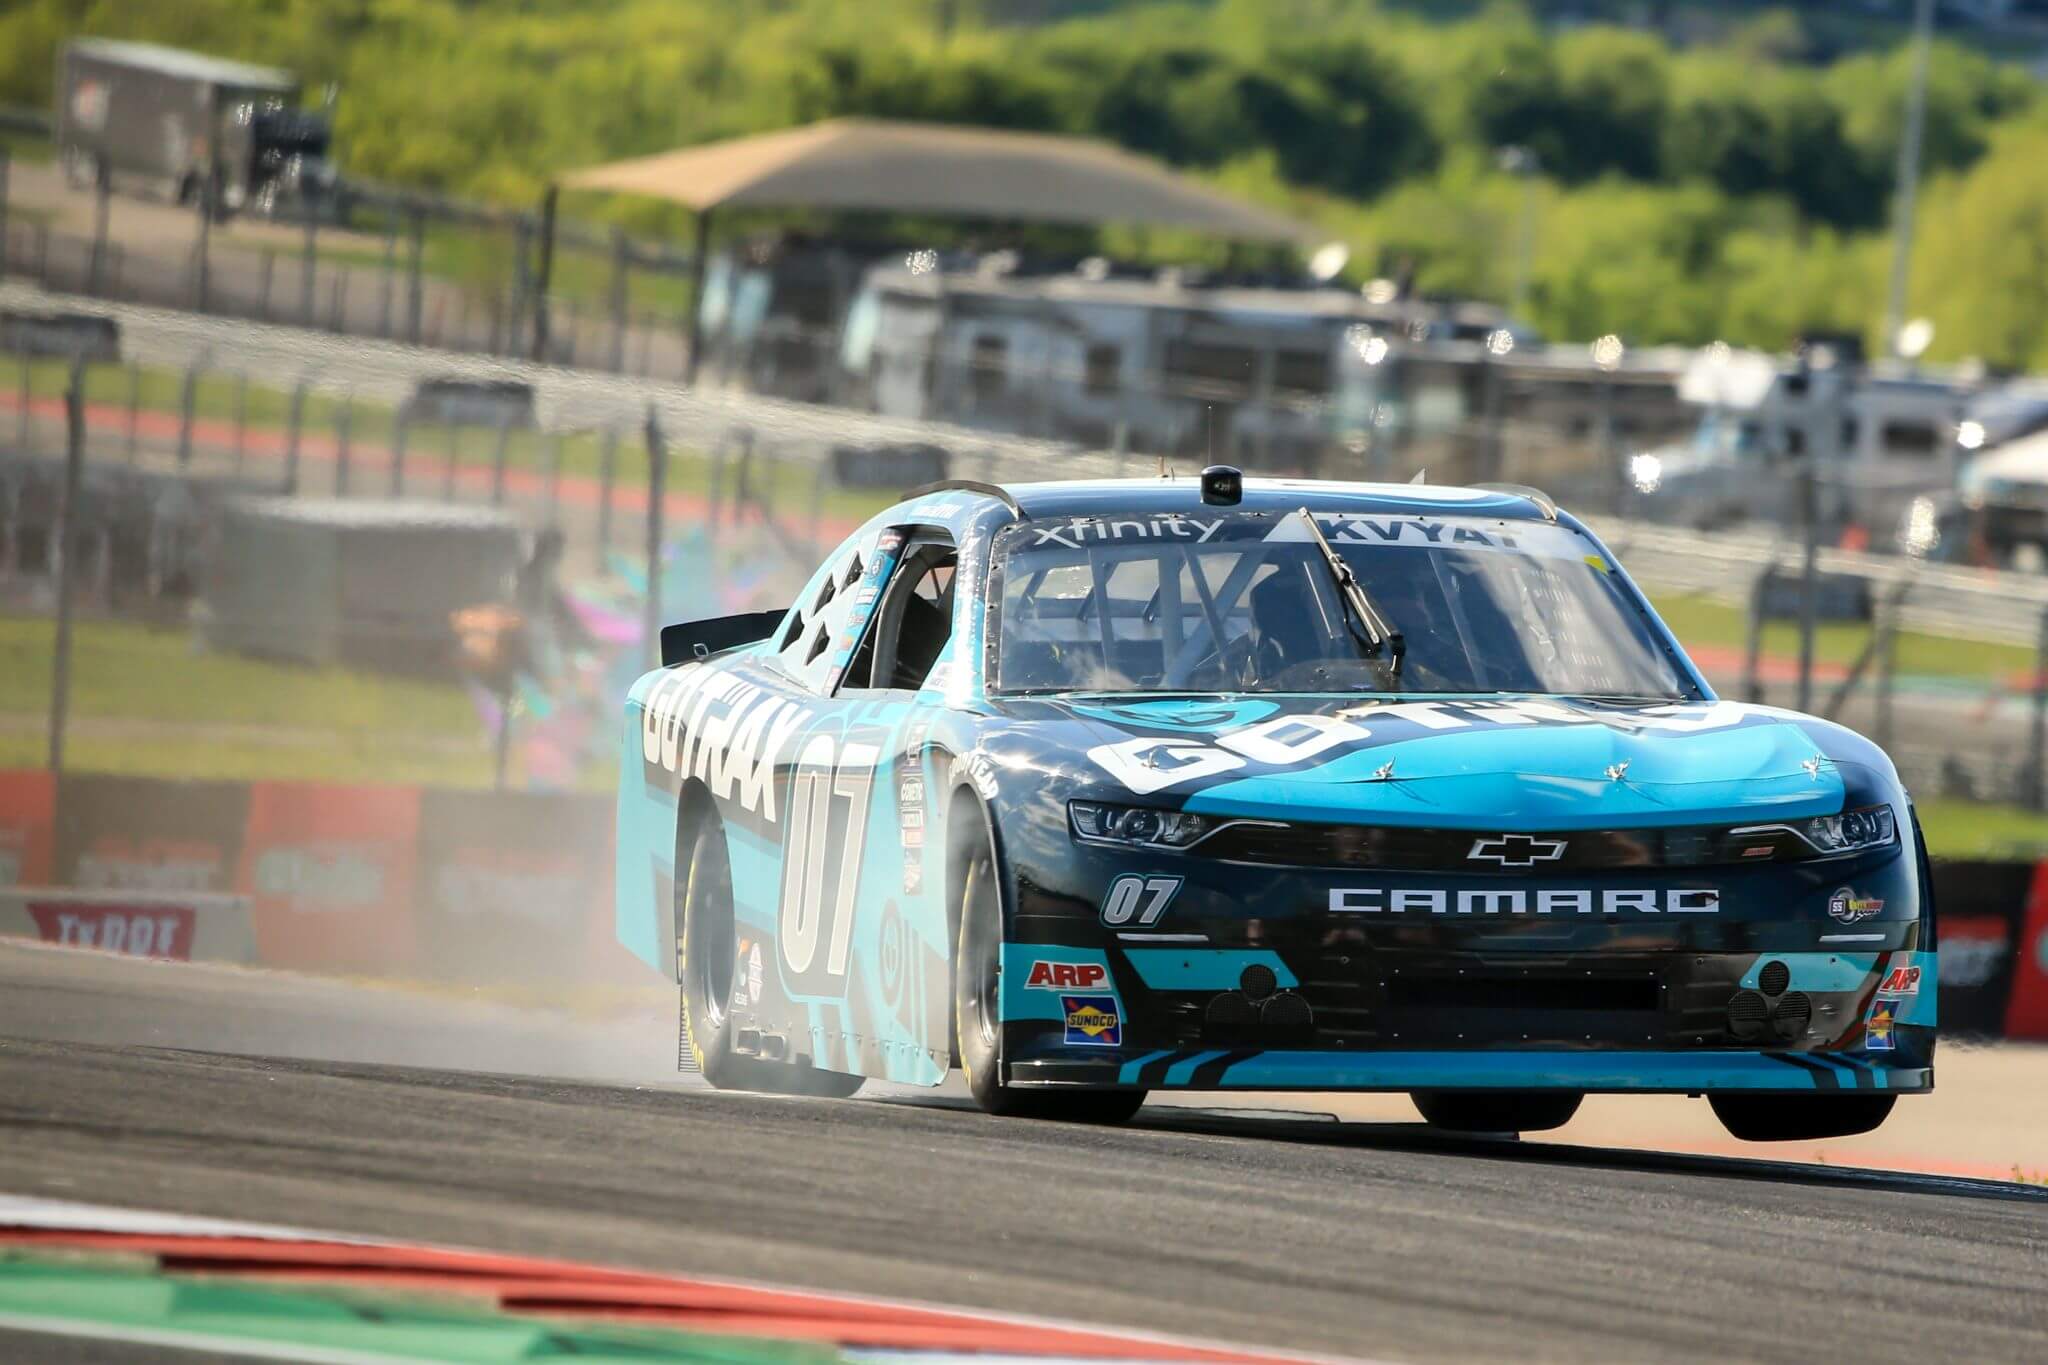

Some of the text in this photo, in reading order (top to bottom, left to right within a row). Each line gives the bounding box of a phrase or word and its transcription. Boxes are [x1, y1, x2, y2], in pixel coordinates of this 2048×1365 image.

[1032, 515, 1225, 548] xfinity
[1316, 519, 1523, 548] KVYAT
[643, 663, 813, 823] GOTRAX
[782, 735, 880, 975] 07
[1104, 878, 1179, 924] 07
[1329, 888, 1720, 913] CAMARO
[57, 913, 181, 957] TxDOT
[1027, 961, 1106, 989] ARP
[1068, 1013, 1116, 1029] SUNOCO
